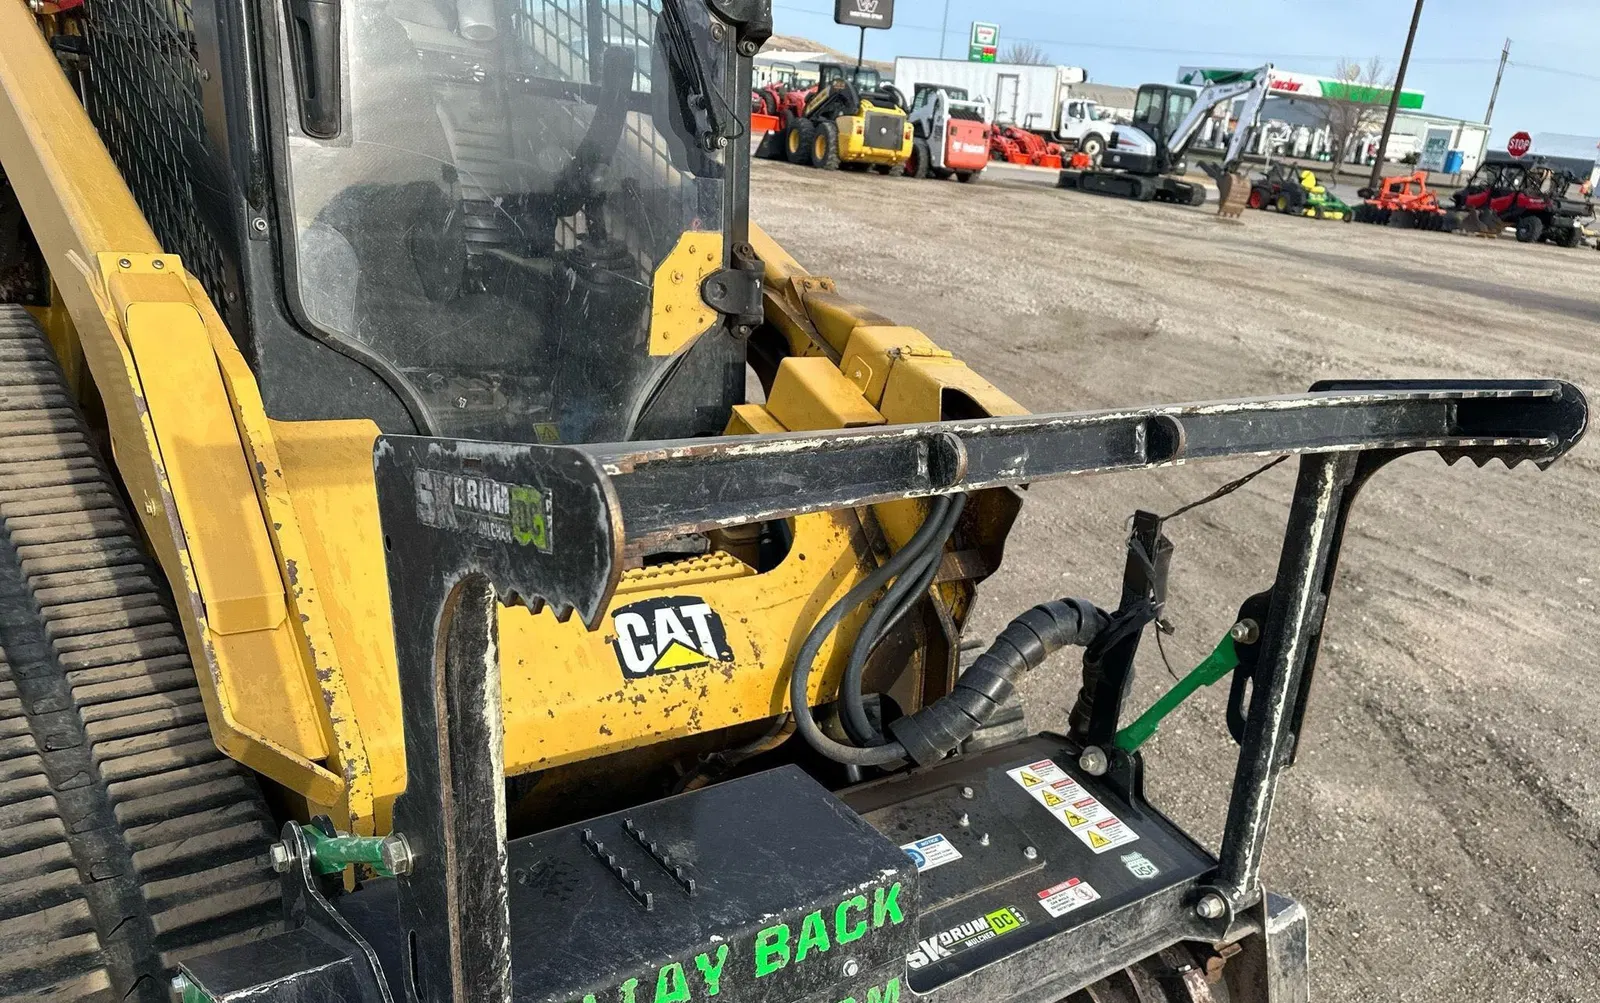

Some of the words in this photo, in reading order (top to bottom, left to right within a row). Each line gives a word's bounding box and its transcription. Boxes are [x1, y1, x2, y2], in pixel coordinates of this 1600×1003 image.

[1509, 138, 1529, 150] STOP
[615, 603, 720, 673] CAT
[1133, 864, 1156, 876] USA
[992, 914, 1014, 929] DC
[755, 882, 904, 978] BACK
[965, 931, 996, 948] MULCHER
